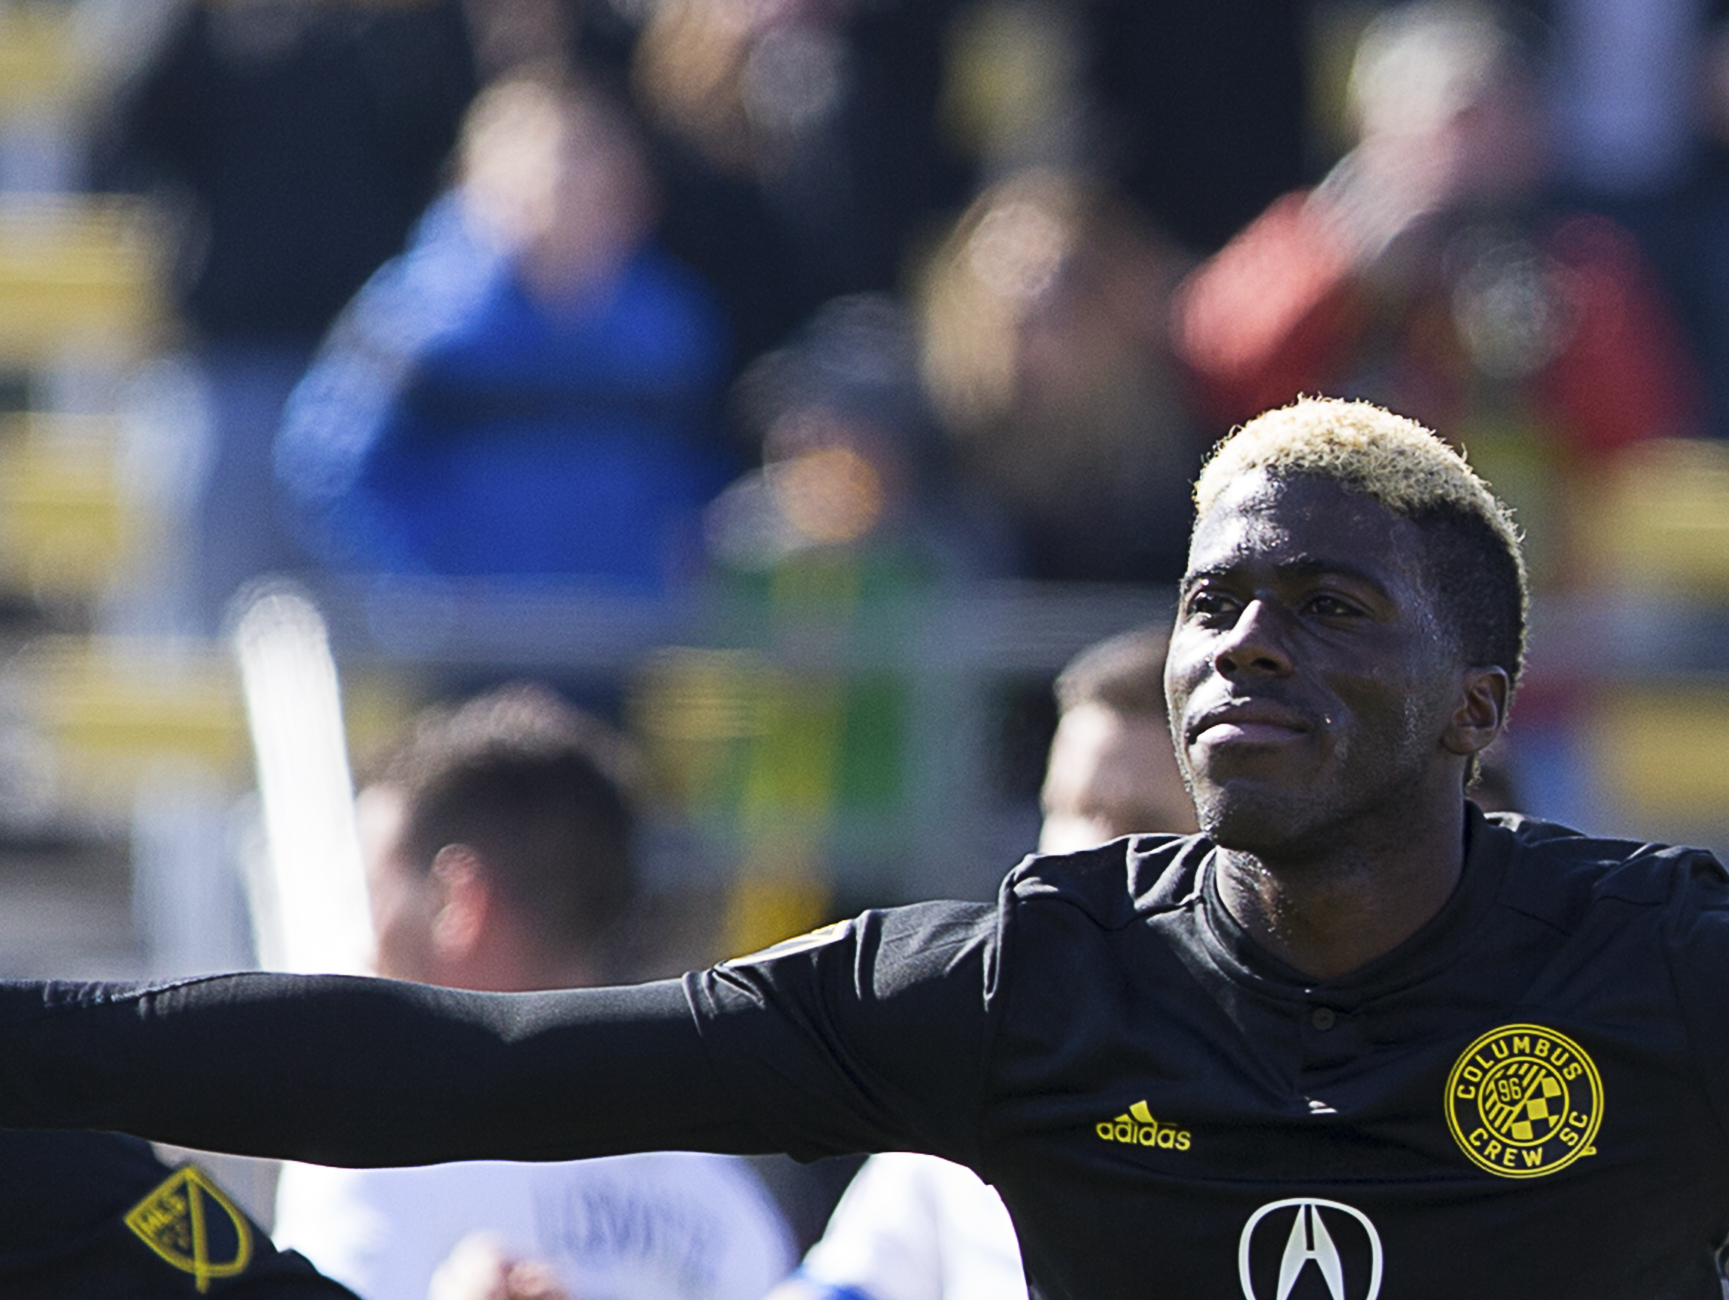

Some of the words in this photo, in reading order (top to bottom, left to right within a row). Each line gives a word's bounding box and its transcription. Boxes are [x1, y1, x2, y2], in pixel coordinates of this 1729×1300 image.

[1456, 1035, 1583, 1100] COLUMBUS
[1497, 1077, 1522, 1102] 96
[1095, 1120, 1191, 1151] adidas
[1469, 1127, 1543, 1168] CREW
[1559, 1111, 1589, 1147] SC
